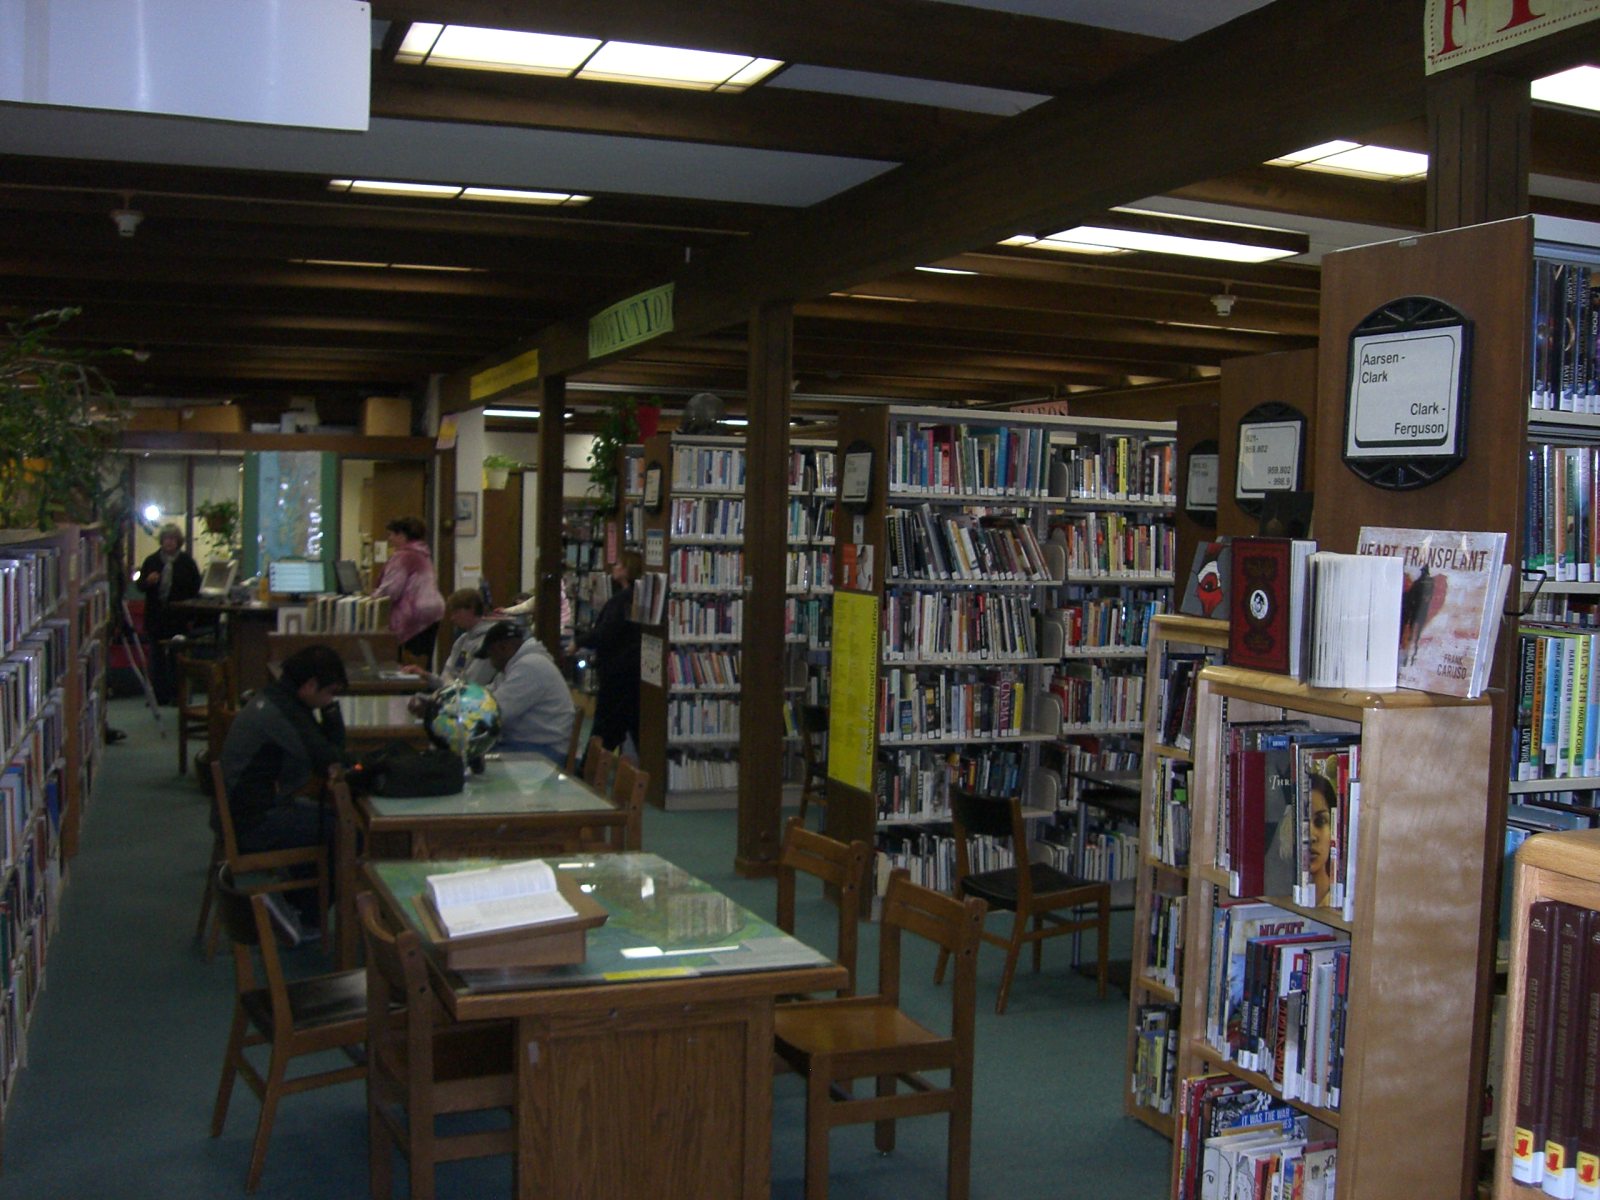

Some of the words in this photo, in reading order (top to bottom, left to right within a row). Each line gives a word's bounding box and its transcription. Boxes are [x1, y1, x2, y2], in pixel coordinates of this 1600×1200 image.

[1362, 353, 1399, 366] Aarsen
[1362, 371, 1388, 384] Clark
[1410, 402, 1439, 416] Clark
[1394, 422, 1444, 438] Ferguson
[1403, 545, 1488, 572] TRANSPLANT
[1443, 653, 1464, 664] FRANK
[1526, 643, 1535, 672] HARLAN
[1568, 649, 1576, 676] HARLAN
[1580, 640, 1590, 672] BACK
[1436, 664, 1467, 680] CARUSO
[1524, 674, 1534, 698] COBE
[1566, 678, 1574, 702] COBEN
[1579, 674, 1589, 703] SPIN
[1001, 682, 1010, 722] CINEMA
[1576, 706, 1584, 736] HARLAN
[1522, 728, 1530, 744] LIVE
[1241, 1115, 1248, 1126] IT
[1250, 1112, 1263, 1126] WAS
[1266, 1110, 1277, 1121] THE
[1277, 1108, 1290, 1120] WAR
